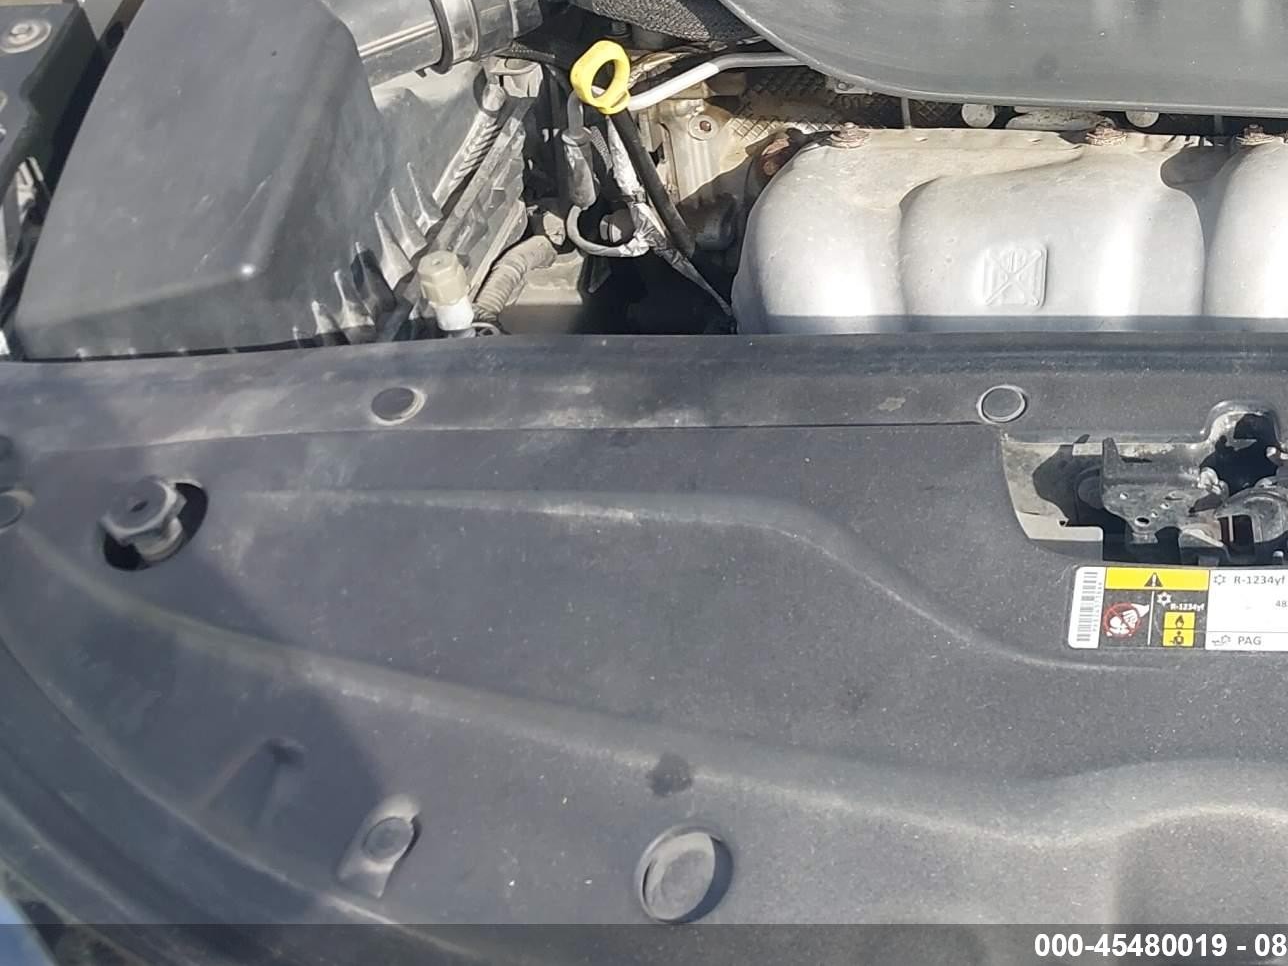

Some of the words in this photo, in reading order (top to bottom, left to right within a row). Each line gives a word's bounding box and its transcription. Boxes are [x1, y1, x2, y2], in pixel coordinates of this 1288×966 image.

[1233, 575, 1286, 586] R-1234yf
[1170, 602, 1205, 611] R-1234yf
[1237, 635, 1262, 646] PAG
